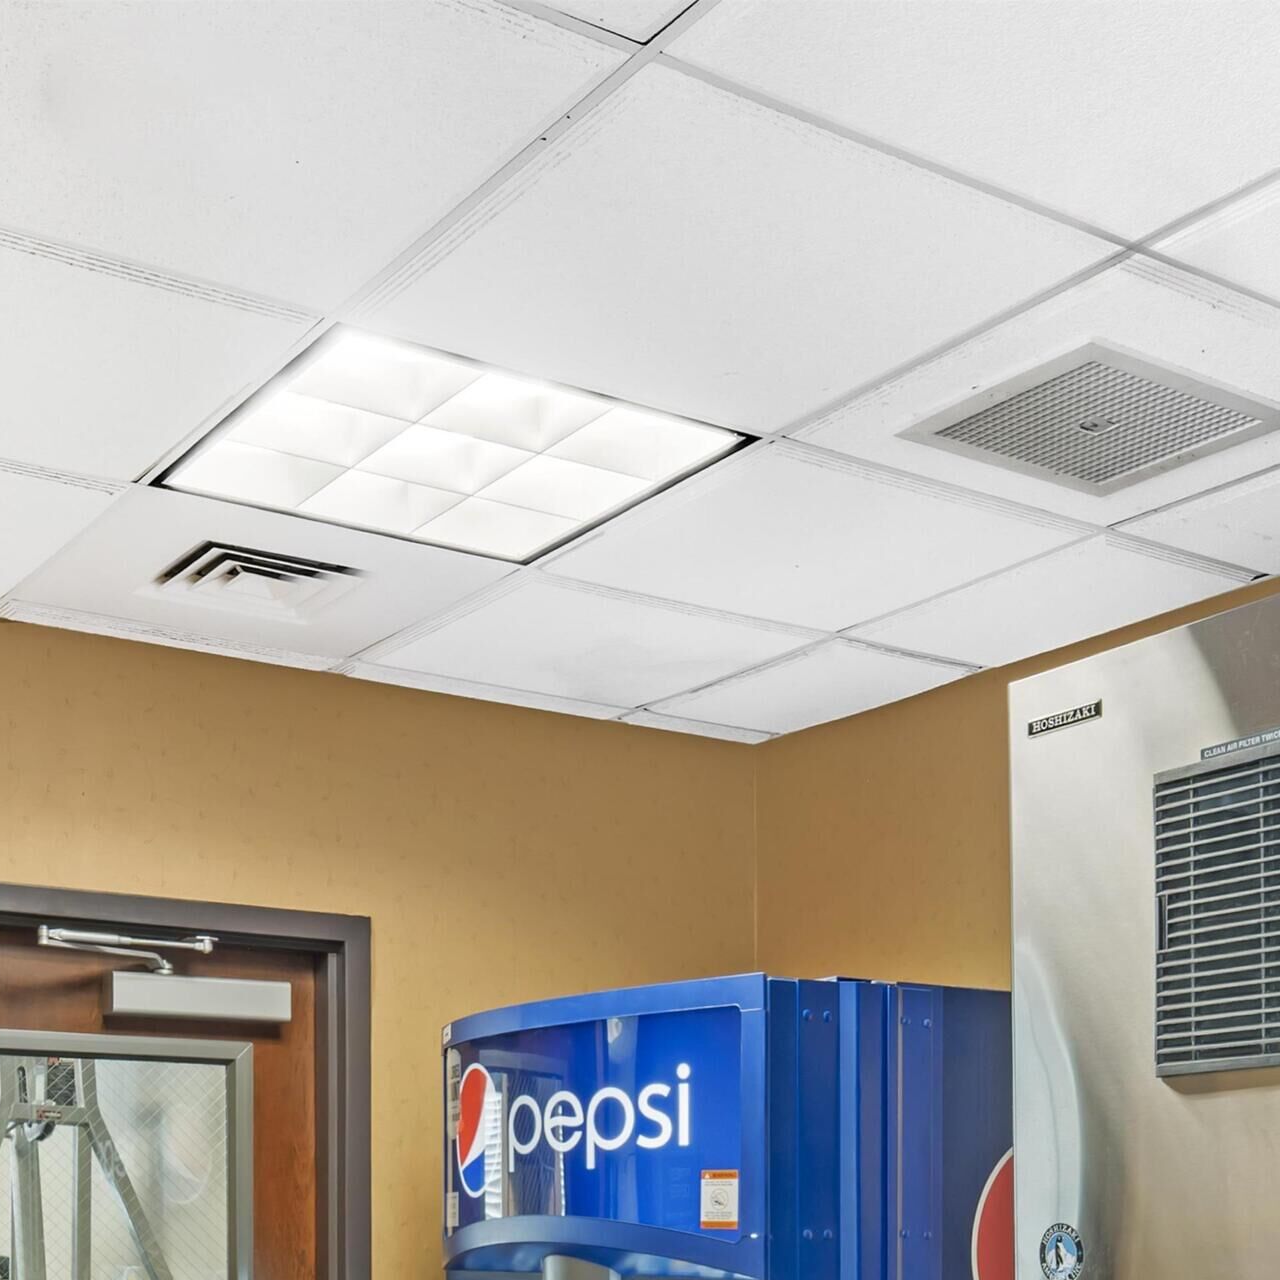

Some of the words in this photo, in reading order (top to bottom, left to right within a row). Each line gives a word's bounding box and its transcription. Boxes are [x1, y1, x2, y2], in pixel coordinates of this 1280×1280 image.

[1032, 704, 1096, 733] HOSHIZAKI
[1204, 745, 1226, 758] CLEAN
[1227, 742, 1238, 752] AIR
[1238, 736, 1260, 748] FILTER
[508, 1062, 691, 1173] pepsi
